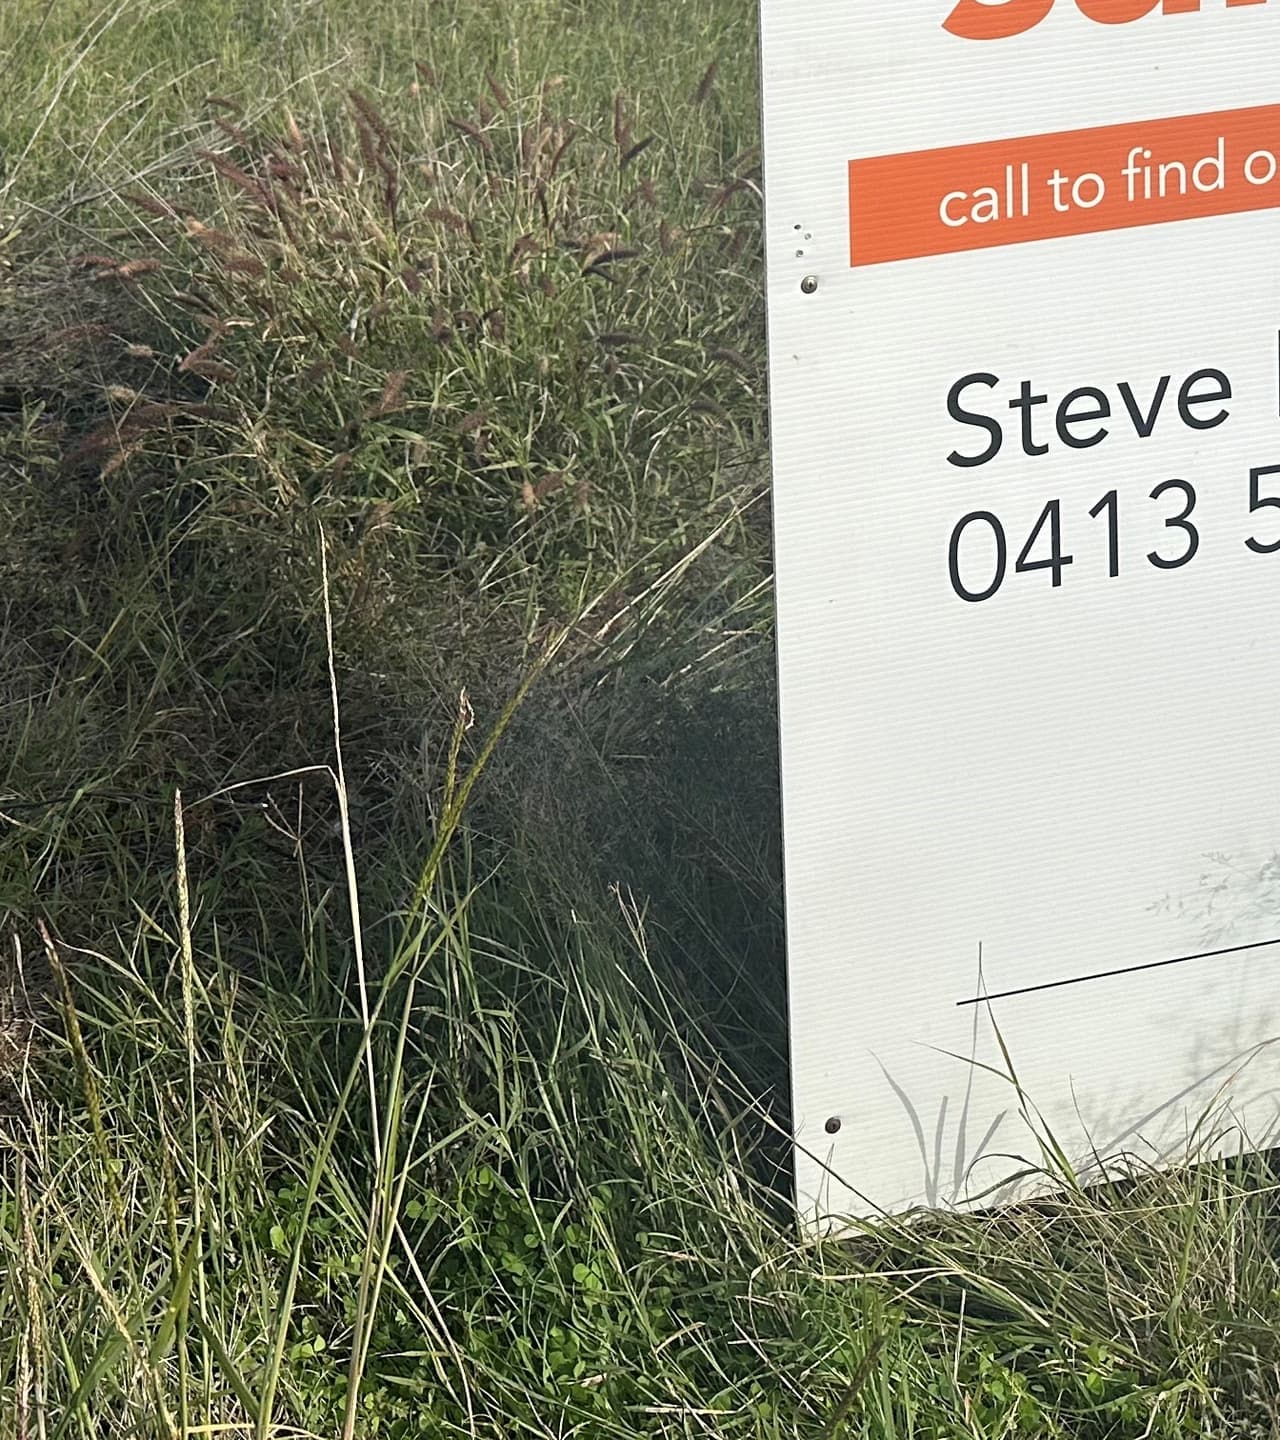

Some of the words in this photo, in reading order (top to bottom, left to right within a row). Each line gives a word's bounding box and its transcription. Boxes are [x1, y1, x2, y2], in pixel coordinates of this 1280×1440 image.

[939, 163, 1029, 227] call
[1047, 169, 1105, 212] to
[1121, 136, 1225, 201] find
[946, 368, 1232, 468] Steve
[948, 478, 1199, 603] 0413
